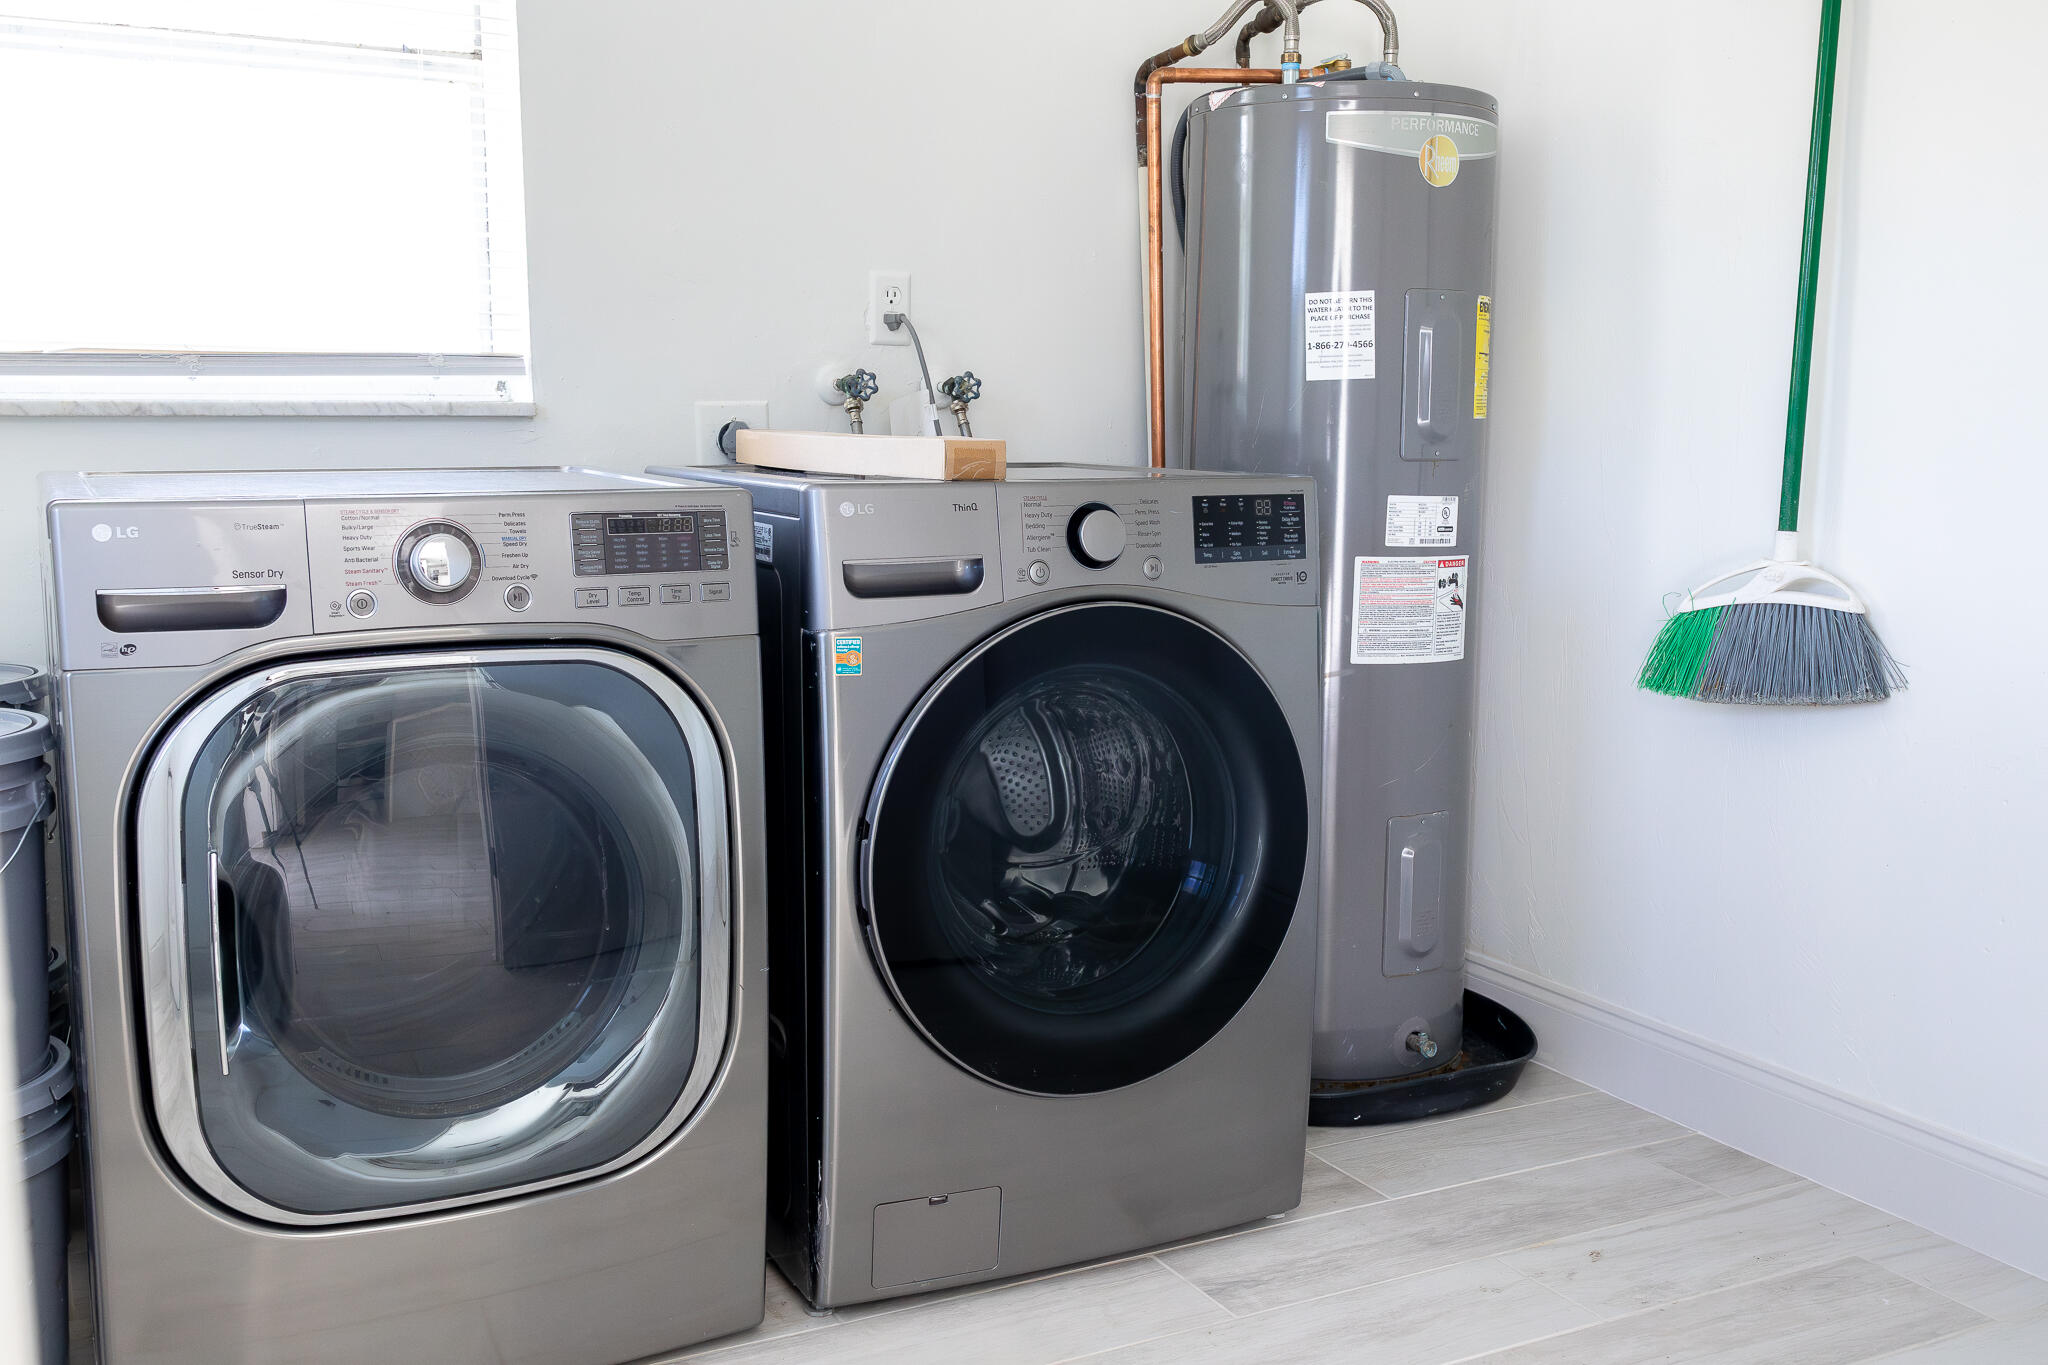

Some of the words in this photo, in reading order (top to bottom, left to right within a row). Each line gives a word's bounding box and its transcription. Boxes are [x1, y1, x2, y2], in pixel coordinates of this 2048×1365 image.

[1391, 117, 1479, 137] PERFORMANCE
[1424, 136, 1457, 179] Rheem
[1339, 313, 1370, 321] PCHASE
[1307, 340, 1373, 350] 1-866-27-4566
[857, 503, 875, 514] LG
[953, 502, 979, 512] ThinQ
[1134, 519, 1148, 527] Speed
[115, 526, 140, 538] LG
[232, 569, 265, 579] Sensor
[267, 568, 284, 580] Dry
[491, 574, 516, 582] Download
[708, 588, 723, 596] Signal
